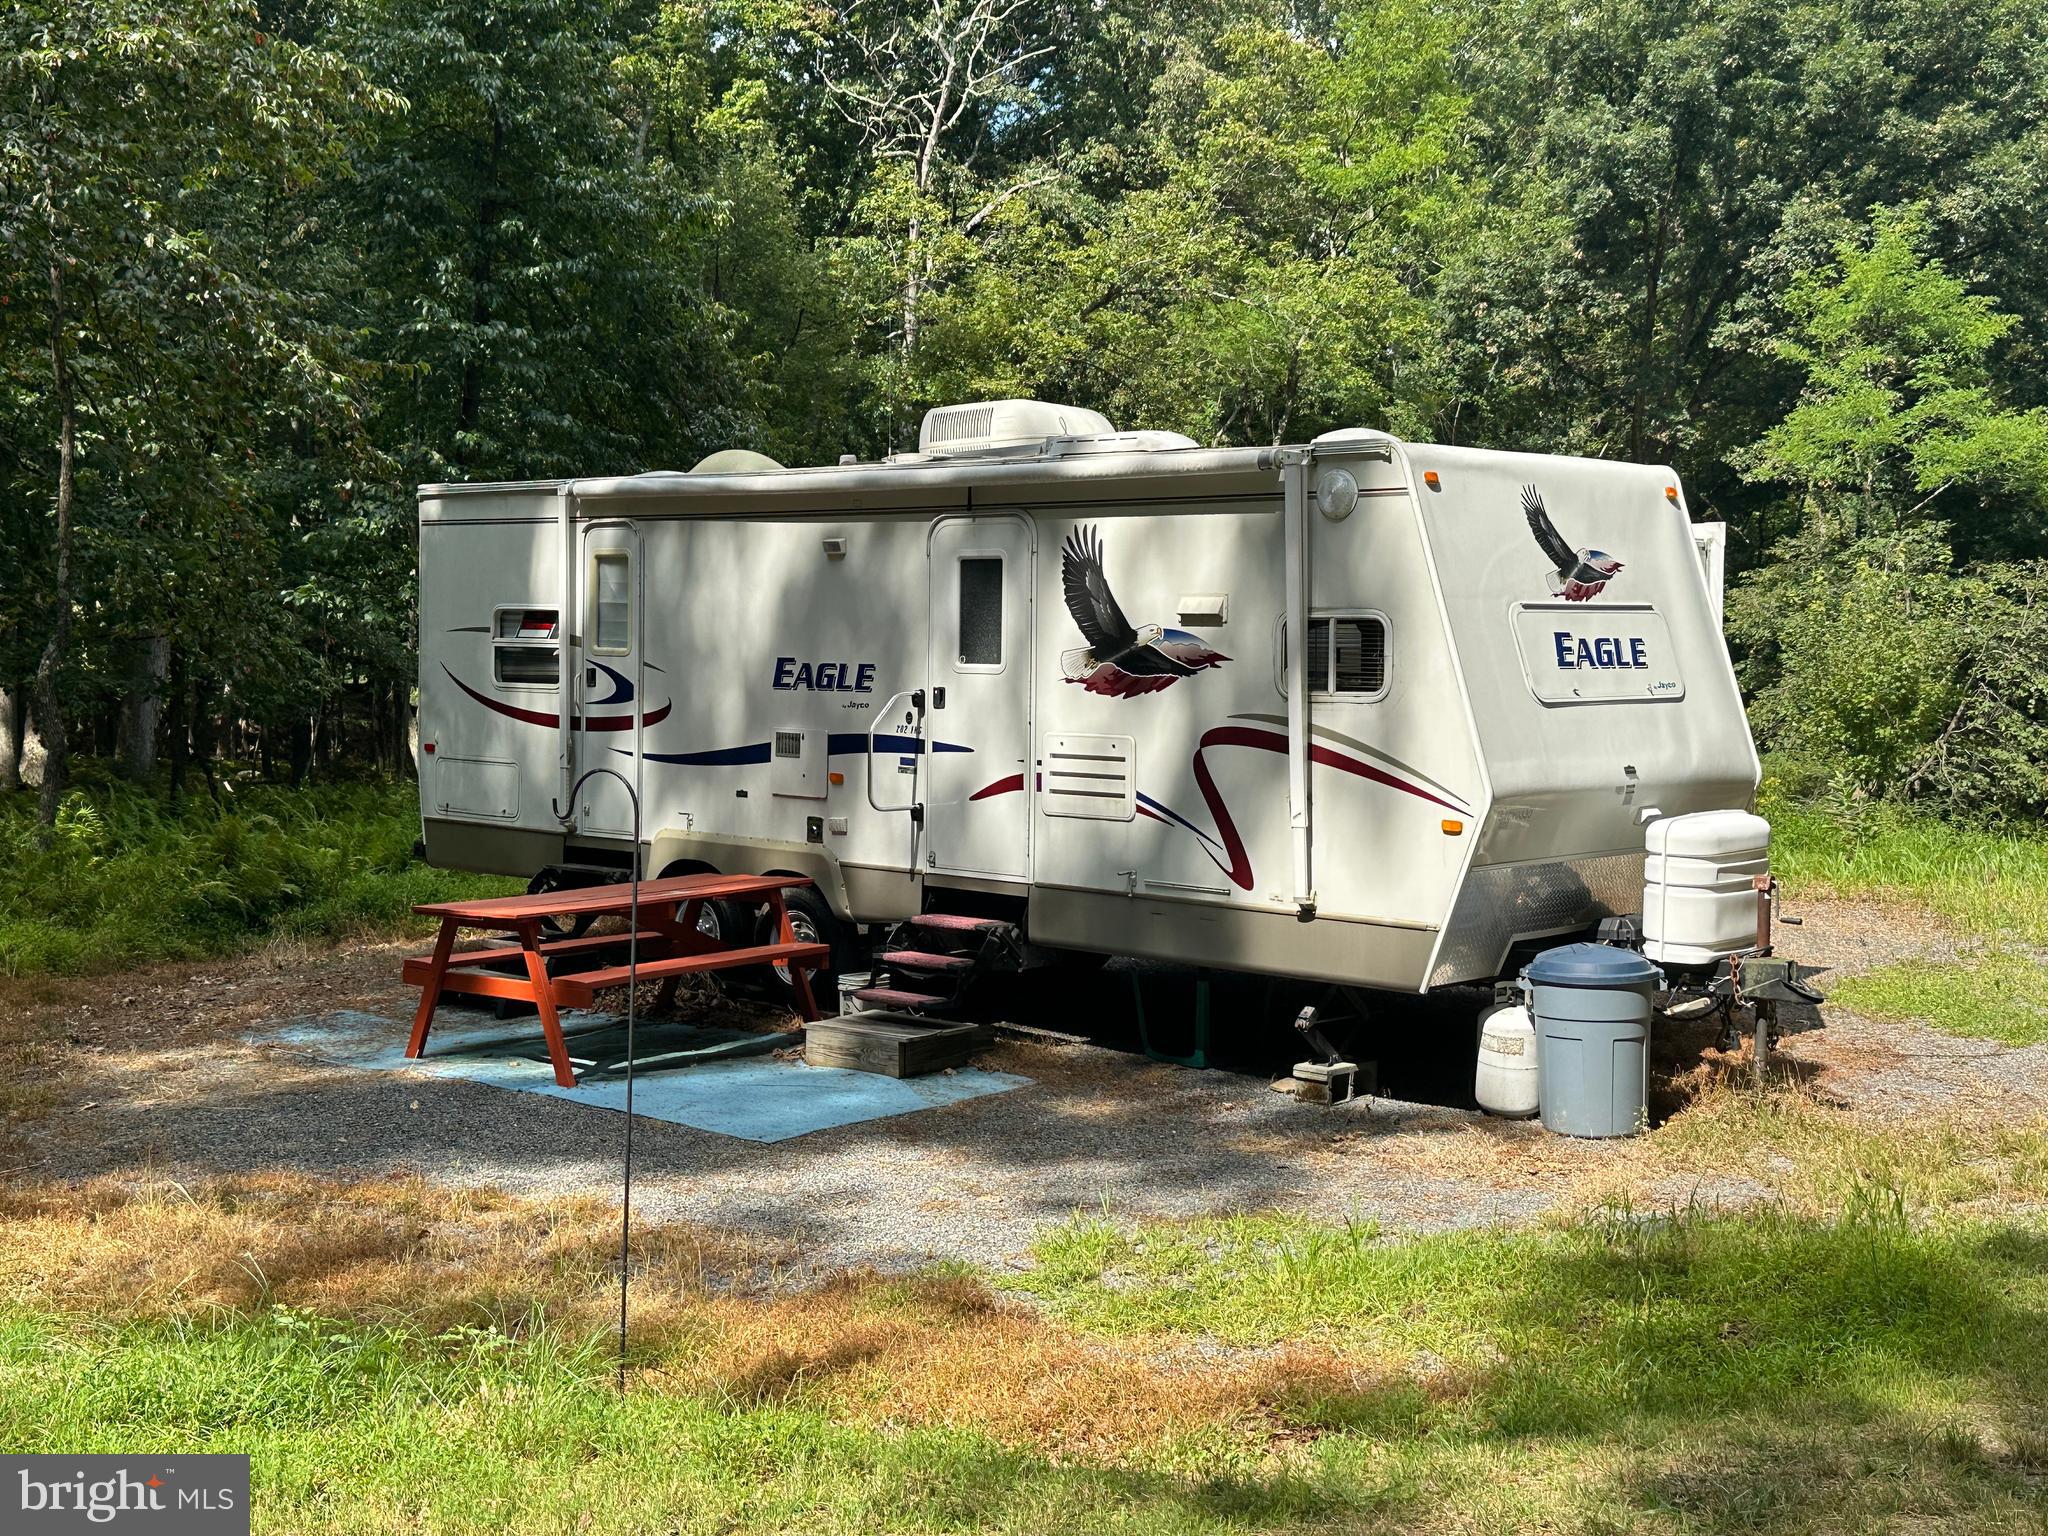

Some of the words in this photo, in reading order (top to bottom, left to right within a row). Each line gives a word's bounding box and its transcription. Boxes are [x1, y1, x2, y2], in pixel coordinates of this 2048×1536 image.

[1553, 631, 1648, 669] EAGLE
[772, 657, 876, 693] EAGLE
[1657, 681, 1676, 690] Jayco
[847, 700, 870, 710] Jayco
